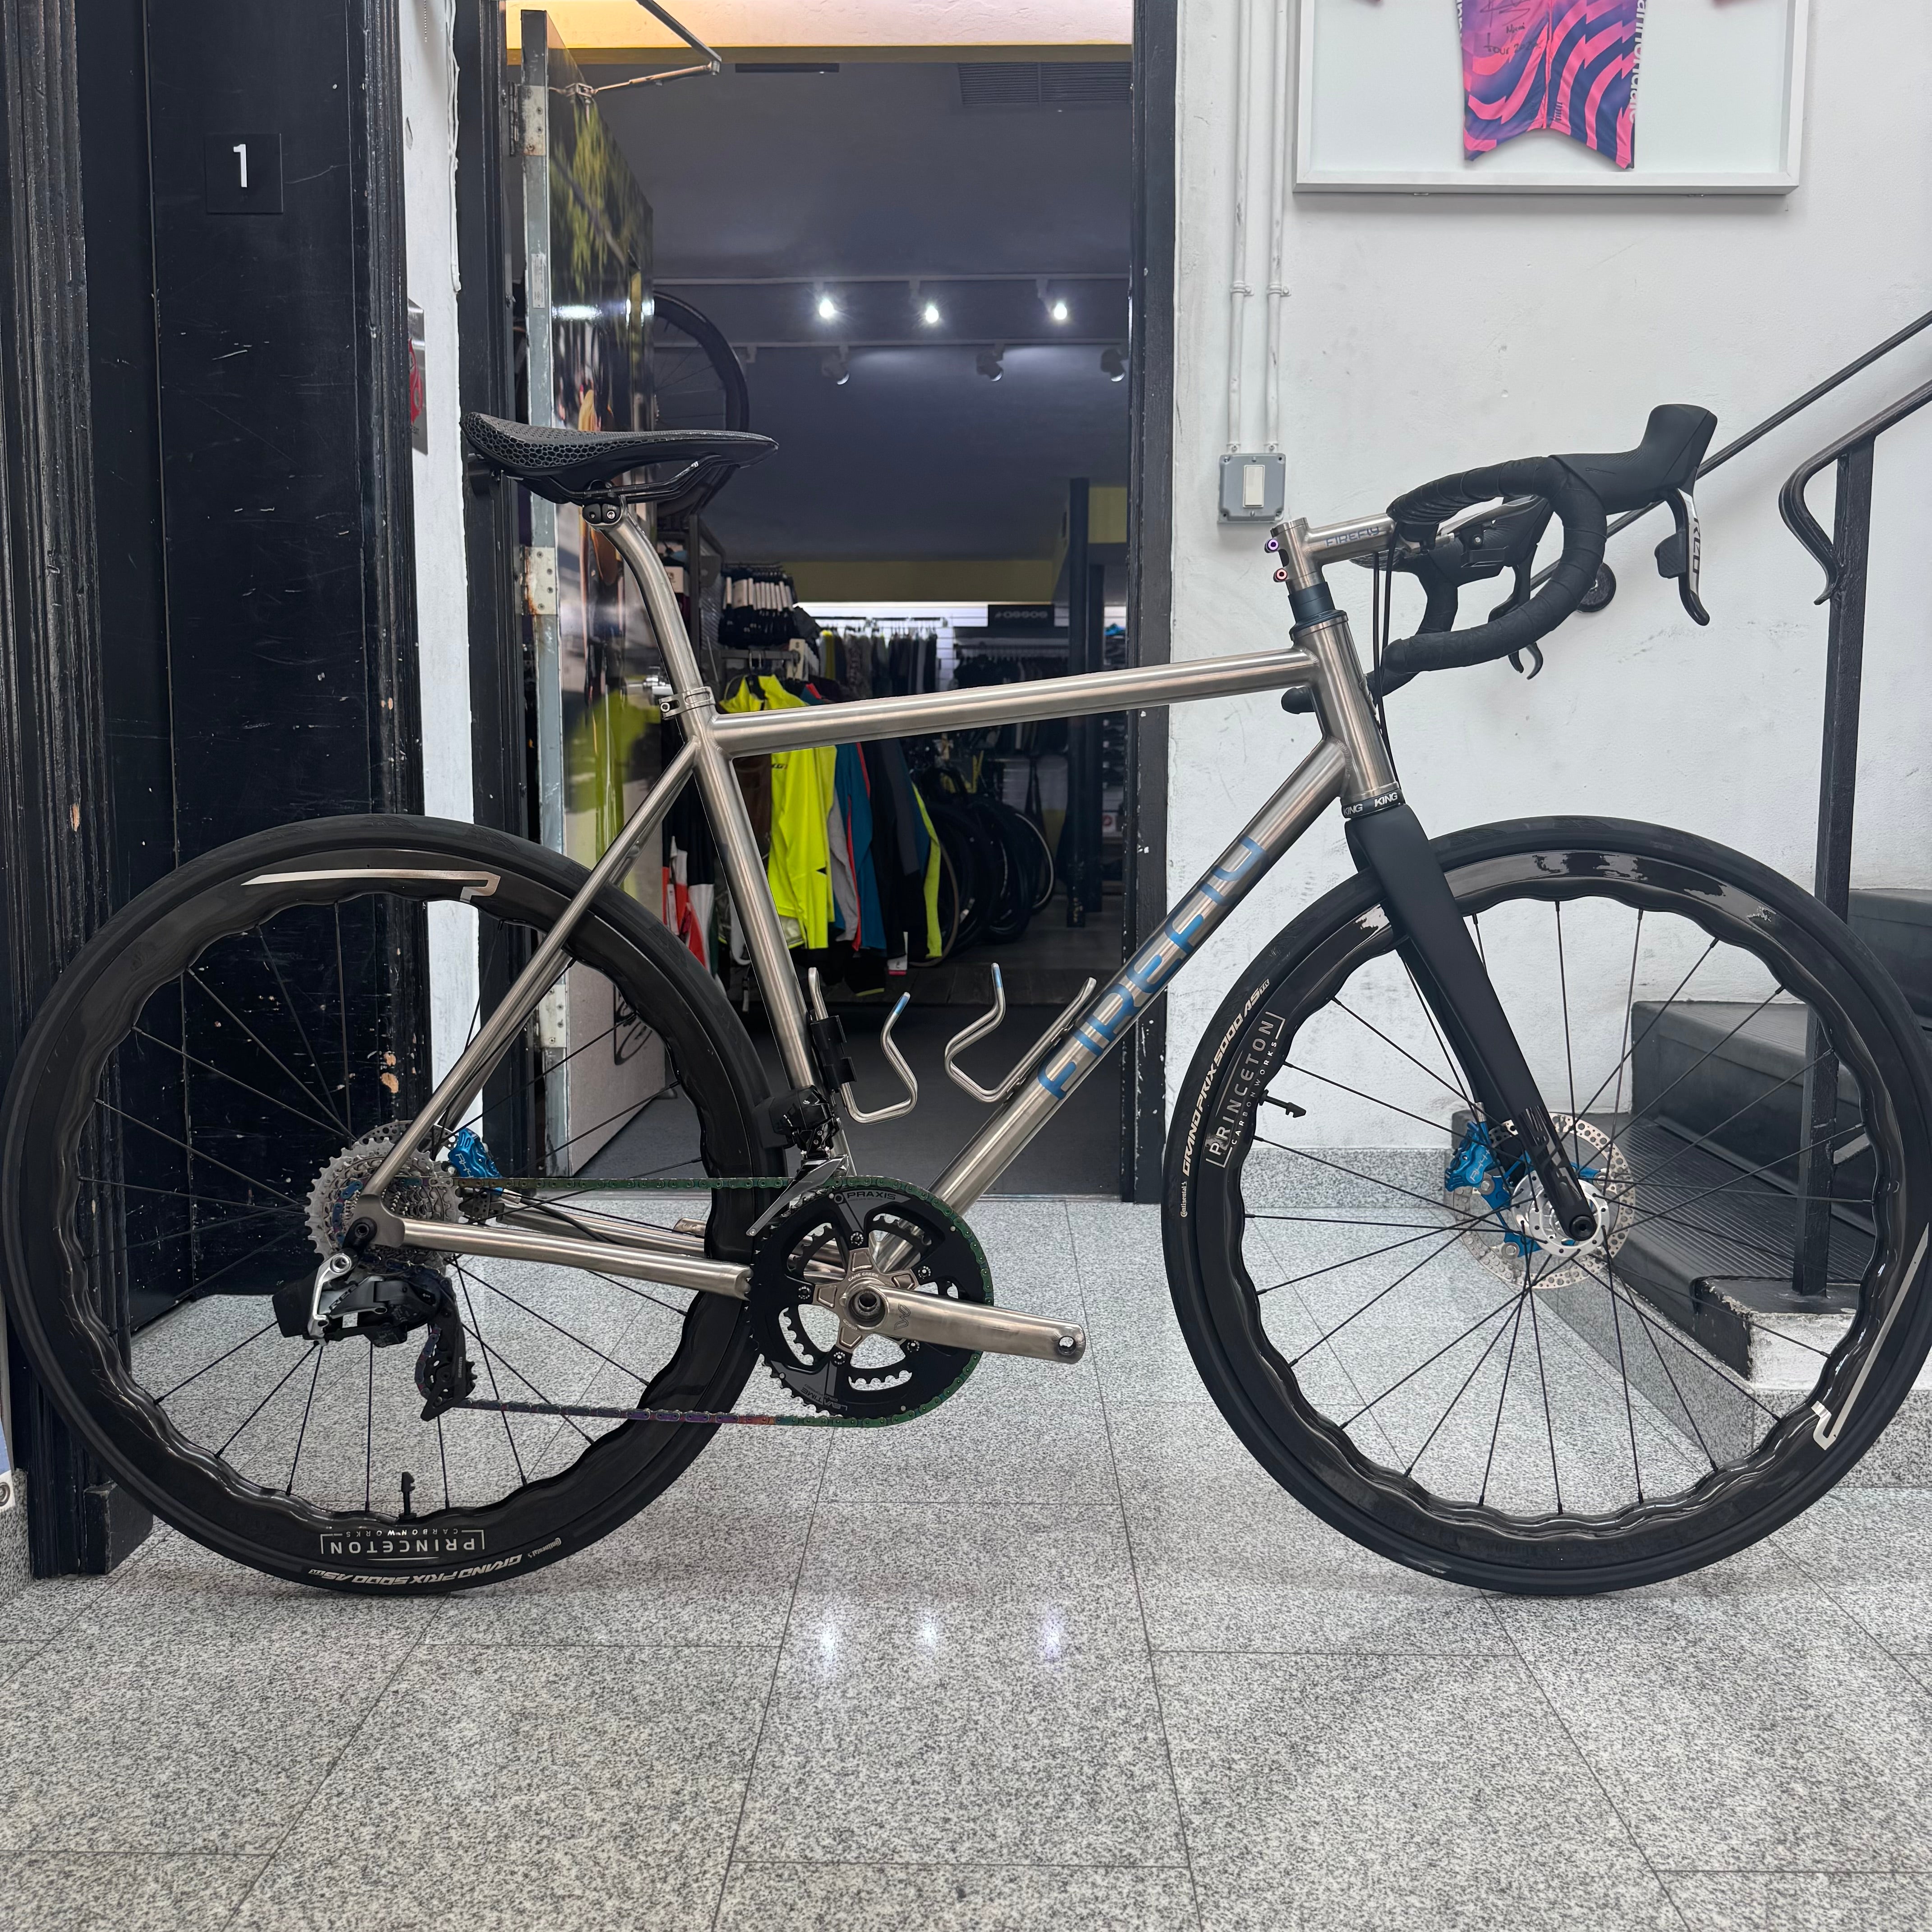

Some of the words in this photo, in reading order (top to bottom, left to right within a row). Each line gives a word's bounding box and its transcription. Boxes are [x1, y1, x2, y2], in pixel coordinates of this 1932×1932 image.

[233, 144, 248, 188] 1
[1325, 525, 1380, 547] FIREFLY
[1343, 804, 1363, 816] KING
[1374, 792, 1398, 807] KING
[1037, 835, 1266, 1100] FIREFLY
[1214, 1013, 1244, 1067] 5000
[1196, 1063, 1217, 1113] PRIX
[1211, 1020, 1274, 1156] PRINCETON
[1182, 1109, 1201, 1177] GRAND
[846, 1191, 897, 1200] PRAXIS
[1180, 1186, 1188, 1217] Continental
[848, 1272, 861, 1282] CANE
[330, 1538, 475, 1555] PRINCETON
[532, 1537, 562, 1557] Continental
[408, 1571, 458, 1584] PRIX
[458, 1554, 523, 1579] GRAND
[352, 1575, 410, 1586] 5000
